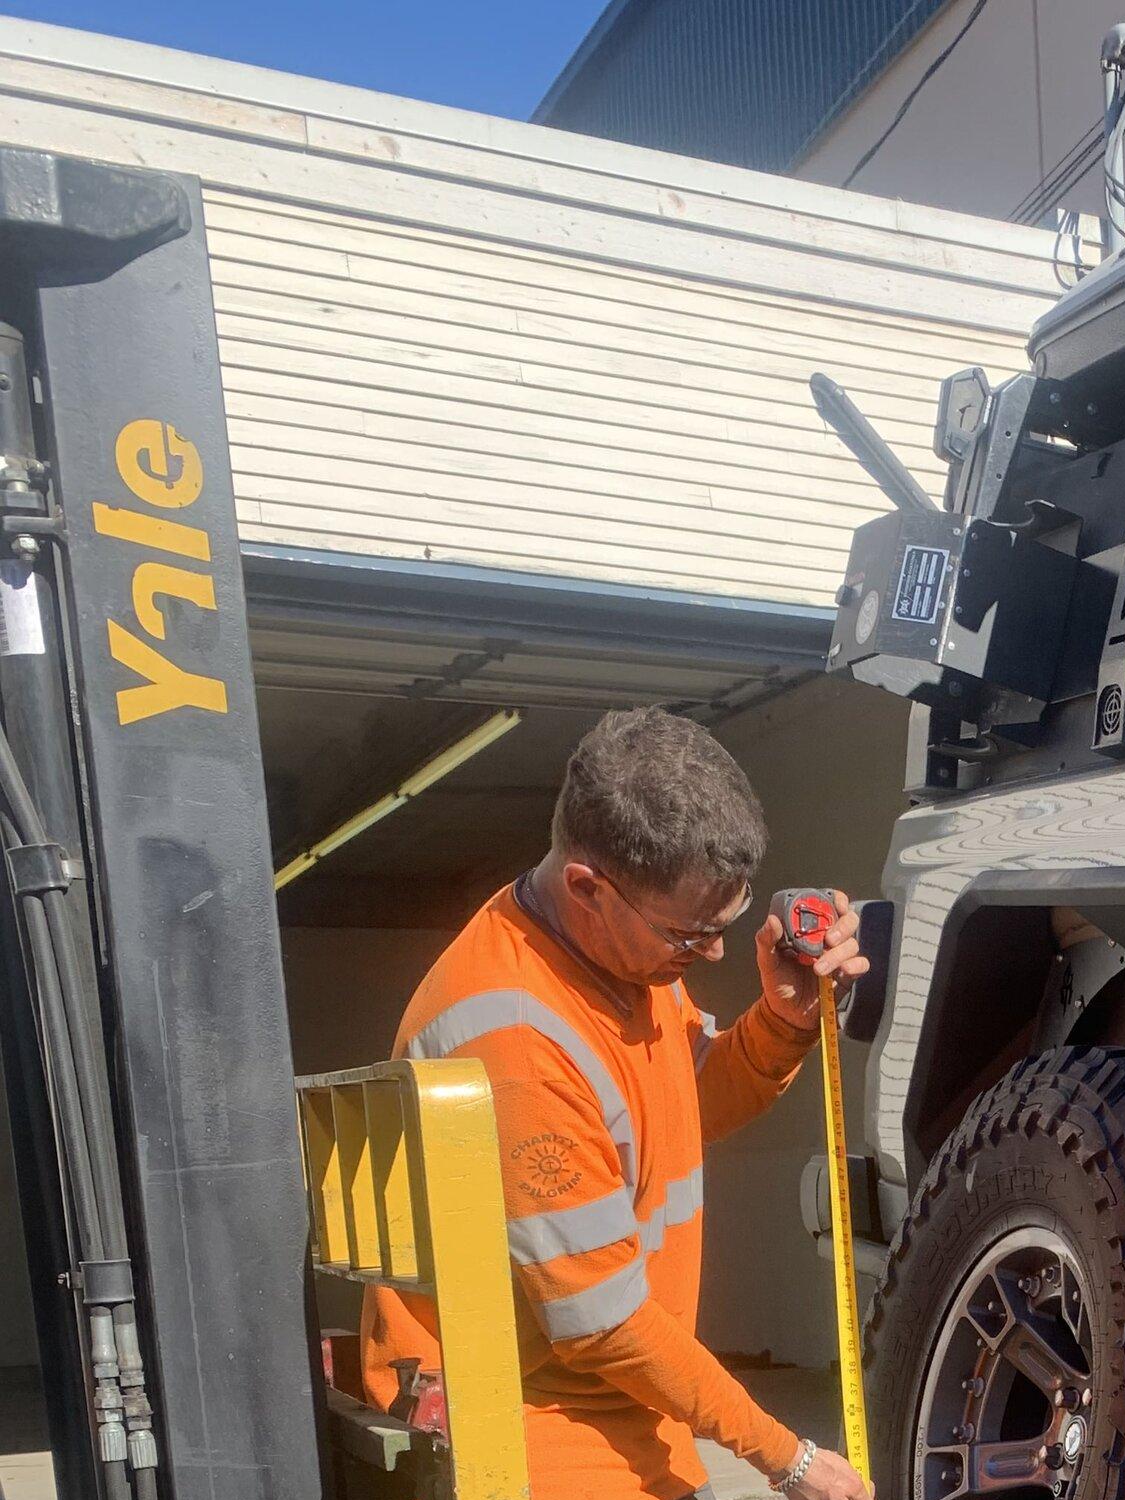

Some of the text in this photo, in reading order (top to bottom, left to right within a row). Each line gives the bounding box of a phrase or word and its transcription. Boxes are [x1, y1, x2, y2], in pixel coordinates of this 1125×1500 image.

[511, 1132, 579, 1160] CHARITY
[518, 1171, 583, 1199] PILGRIM
[848, 1339, 857, 1354] 39
[849, 1360, 857, 1375] 38
[850, 1382, 859, 1397] 37
[852, 1424, 861, 1438] 35
[854, 1445, 862, 1458] 34
